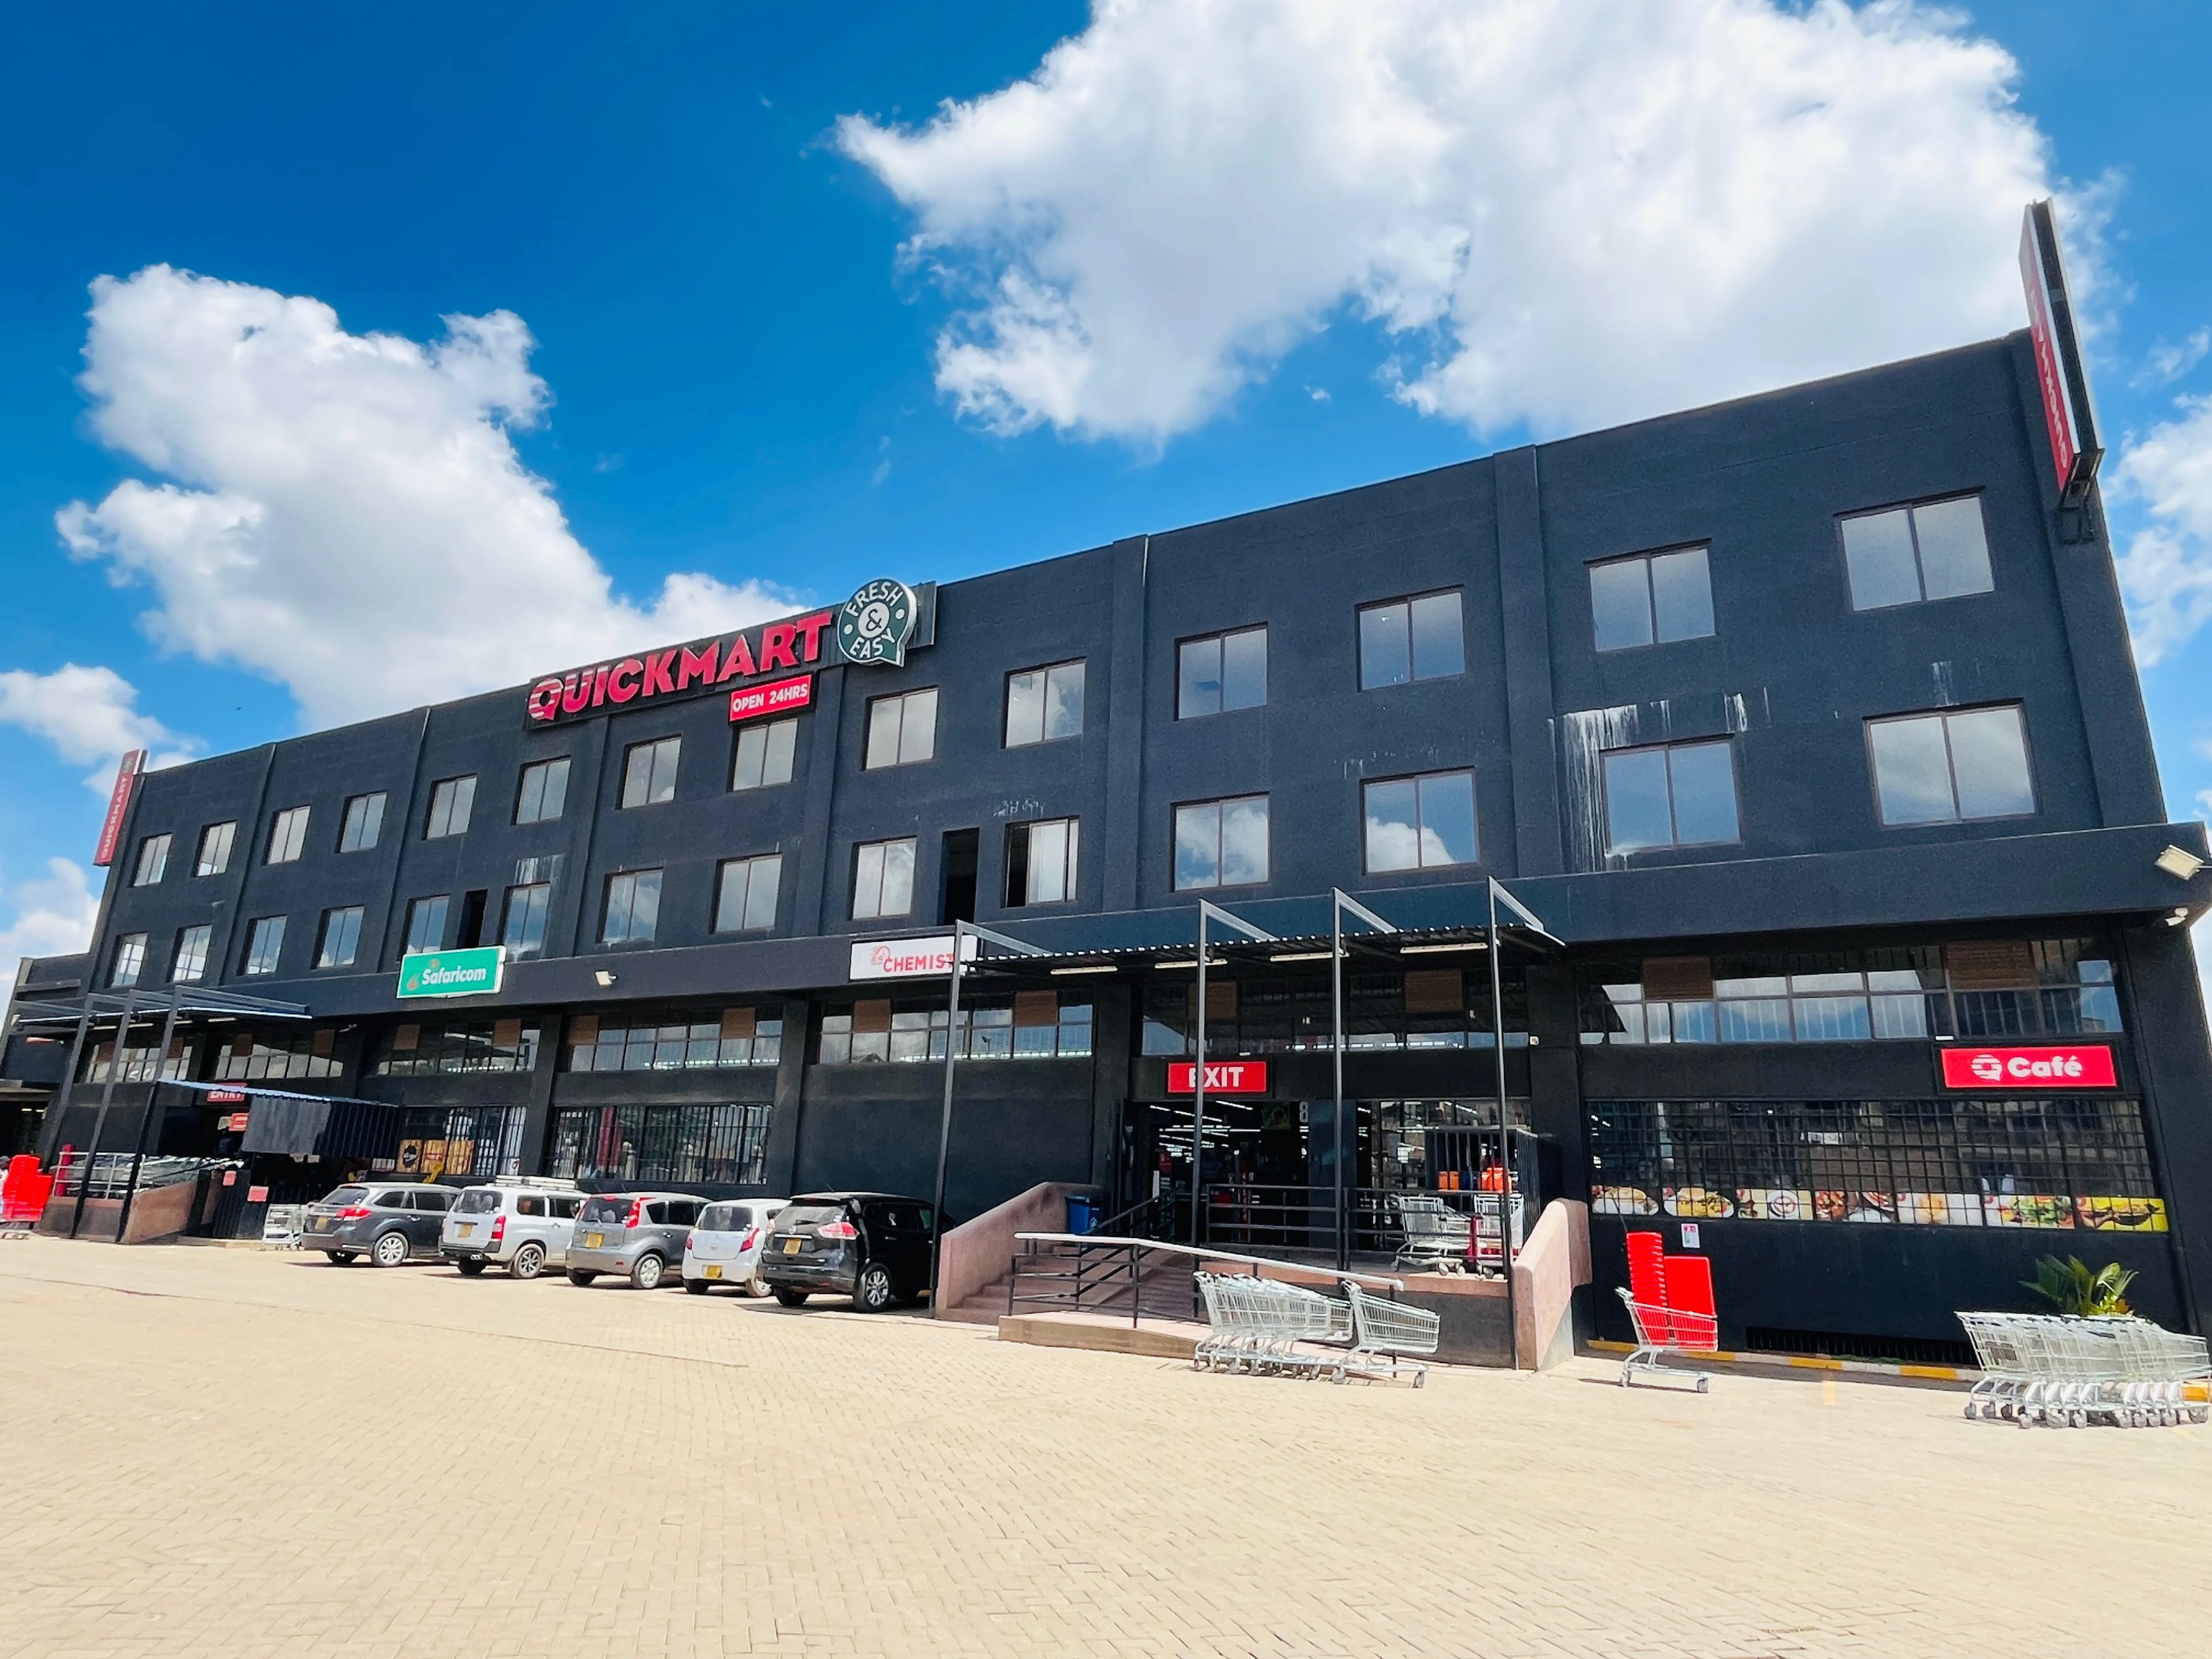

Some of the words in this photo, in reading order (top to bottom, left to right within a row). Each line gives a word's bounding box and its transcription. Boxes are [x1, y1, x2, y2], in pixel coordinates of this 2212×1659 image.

[846, 582, 903, 617] FRESH
[866, 609, 882, 631] &
[849, 628, 895, 658] EASY
[529, 612, 832, 721] QUICKMART
[732, 693, 764, 713] OPEN
[769, 682, 808, 706] 24HRS
[101, 775, 128, 858] QUICKMART
[421, 965, 487, 985] Safaricom
[884, 953, 956, 972] CHEMIST
[1188, 1067, 1244, 1088] EXIT
[2007, 1056, 2083, 1078] Café
